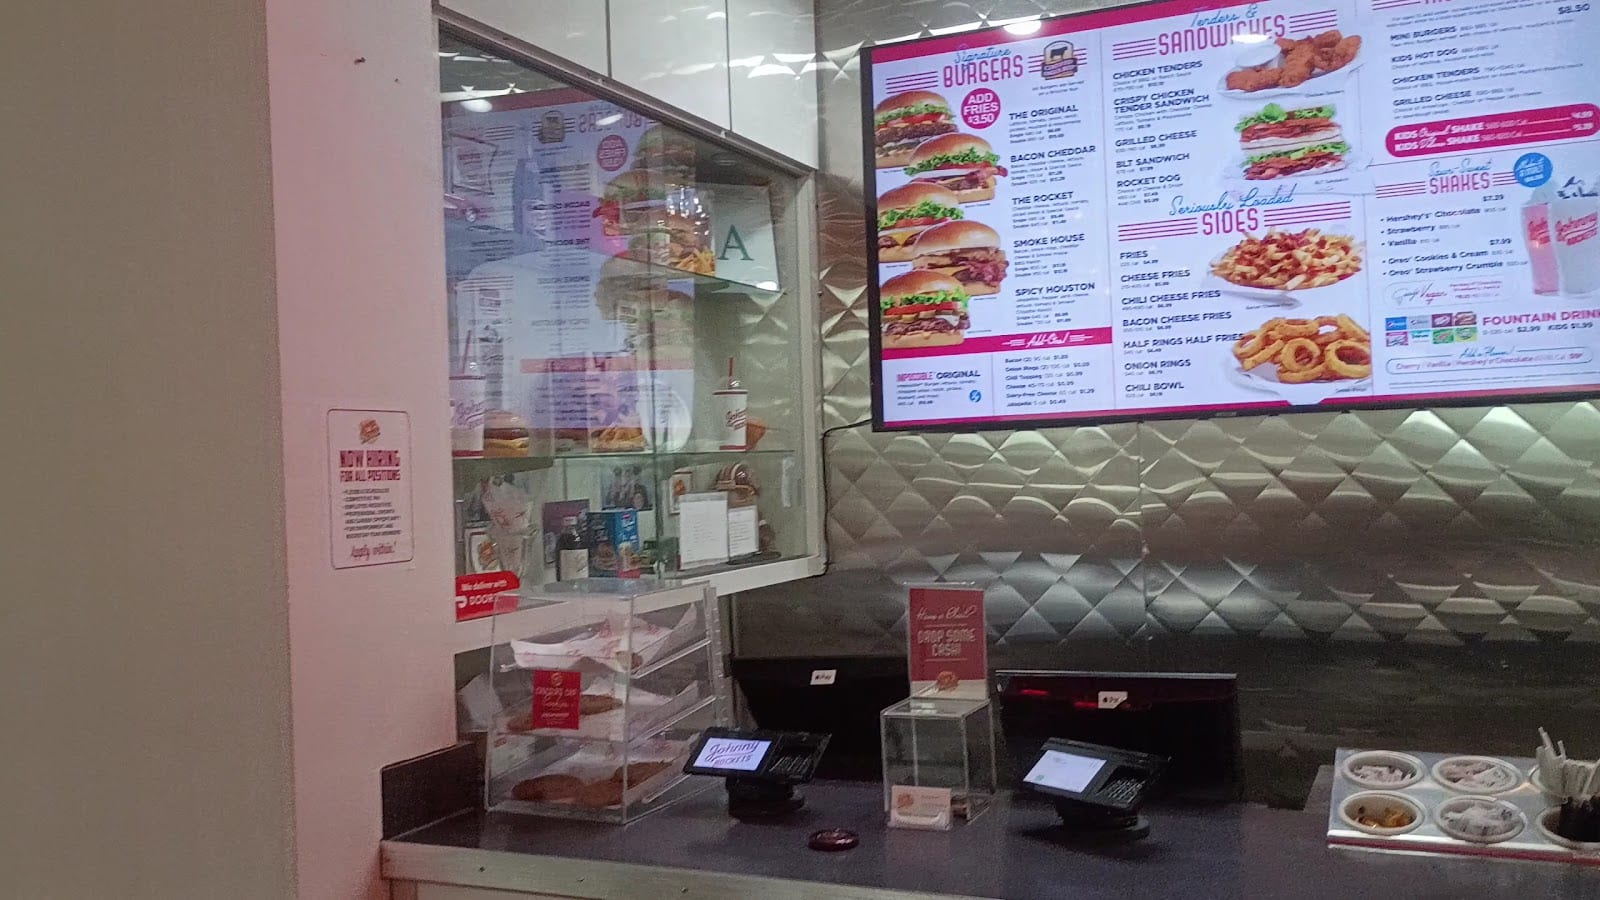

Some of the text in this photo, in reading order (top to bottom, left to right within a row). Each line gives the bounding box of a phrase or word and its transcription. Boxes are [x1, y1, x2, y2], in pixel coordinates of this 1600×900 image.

[1191, 8, 1239, 27] Tenders
[1158, 14, 1285, 55] SANDWICHES
[1415, 51, 1434, 60] HOT
[1436, 48, 1458, 57] DOG
[943, 54, 1023, 88] BURGERS
[1113, 60, 1203, 80] CHICKEN TENDERS
[1392, 67, 1480, 85] CHICKEN TENDERS
[968, 93, 993, 104] ADD
[1114, 88, 1194, 105] CRISPY CHICKEN
[1114, 94, 1209, 113] TENDER SANDWICH
[1393, 90, 1472, 106] GRILLED CHEESE
[963, 102, 999, 115] FRIES
[1008, 105, 1079, 120] THE ORIGINAL
[968, 113, 994, 125] $3.50
[1115, 130, 1197, 147] GRILLED CHEESE
[1010, 145, 1096, 163] BACON CHEDDAR
[1115, 153, 1190, 168] BLT SANDWICH
[1117, 174, 1181, 188] ROCKET DOG
[1430, 172, 1490, 194] SHAKES
[1011, 191, 1074, 206] THE ROCKET
[1169, 183, 1297, 216] Seriously Loaded
[1434, 208, 1480, 217] Chocolate
[1202, 208, 1258, 235] SIDES
[1387, 225, 1435, 235] Strawberry
[717, 224, 753, 261] A
[1013, 233, 1085, 248] SMOKE HOUSE
[1120, 250, 1148, 260] FRIES
[1414, 254, 1449, 262] Cookies
[1459, 250, 1489, 259] Cream
[1415, 265, 1464, 274] Strawberry
[1466, 262, 1503, 270] Crumble
[1121, 269, 1191, 283] CHEESE FRIES
[1015, 282, 1095, 296] SPICY HOUSTON
[1121, 290, 1221, 305] CHILI CHEESE FRIES
[1122, 311, 1232, 327] BACON CHEESE FRIES
[1483, 309, 1600, 326] FOUNTAIN DRIN
[1123, 339, 1149, 349] HALF
[1152, 337, 1183, 346] RINGS
[1185, 335, 1213, 344] HALF
[1124, 359, 1191, 370] ONION RINGS
[936, 370, 981, 380] ORIGINAL
[1125, 382, 1185, 392] CHILI BOWL
[368, 470, 400, 481] POSITIONS
[917, 628, 976, 644] DROP SOME
[705, 740, 760, 762] Johnny
